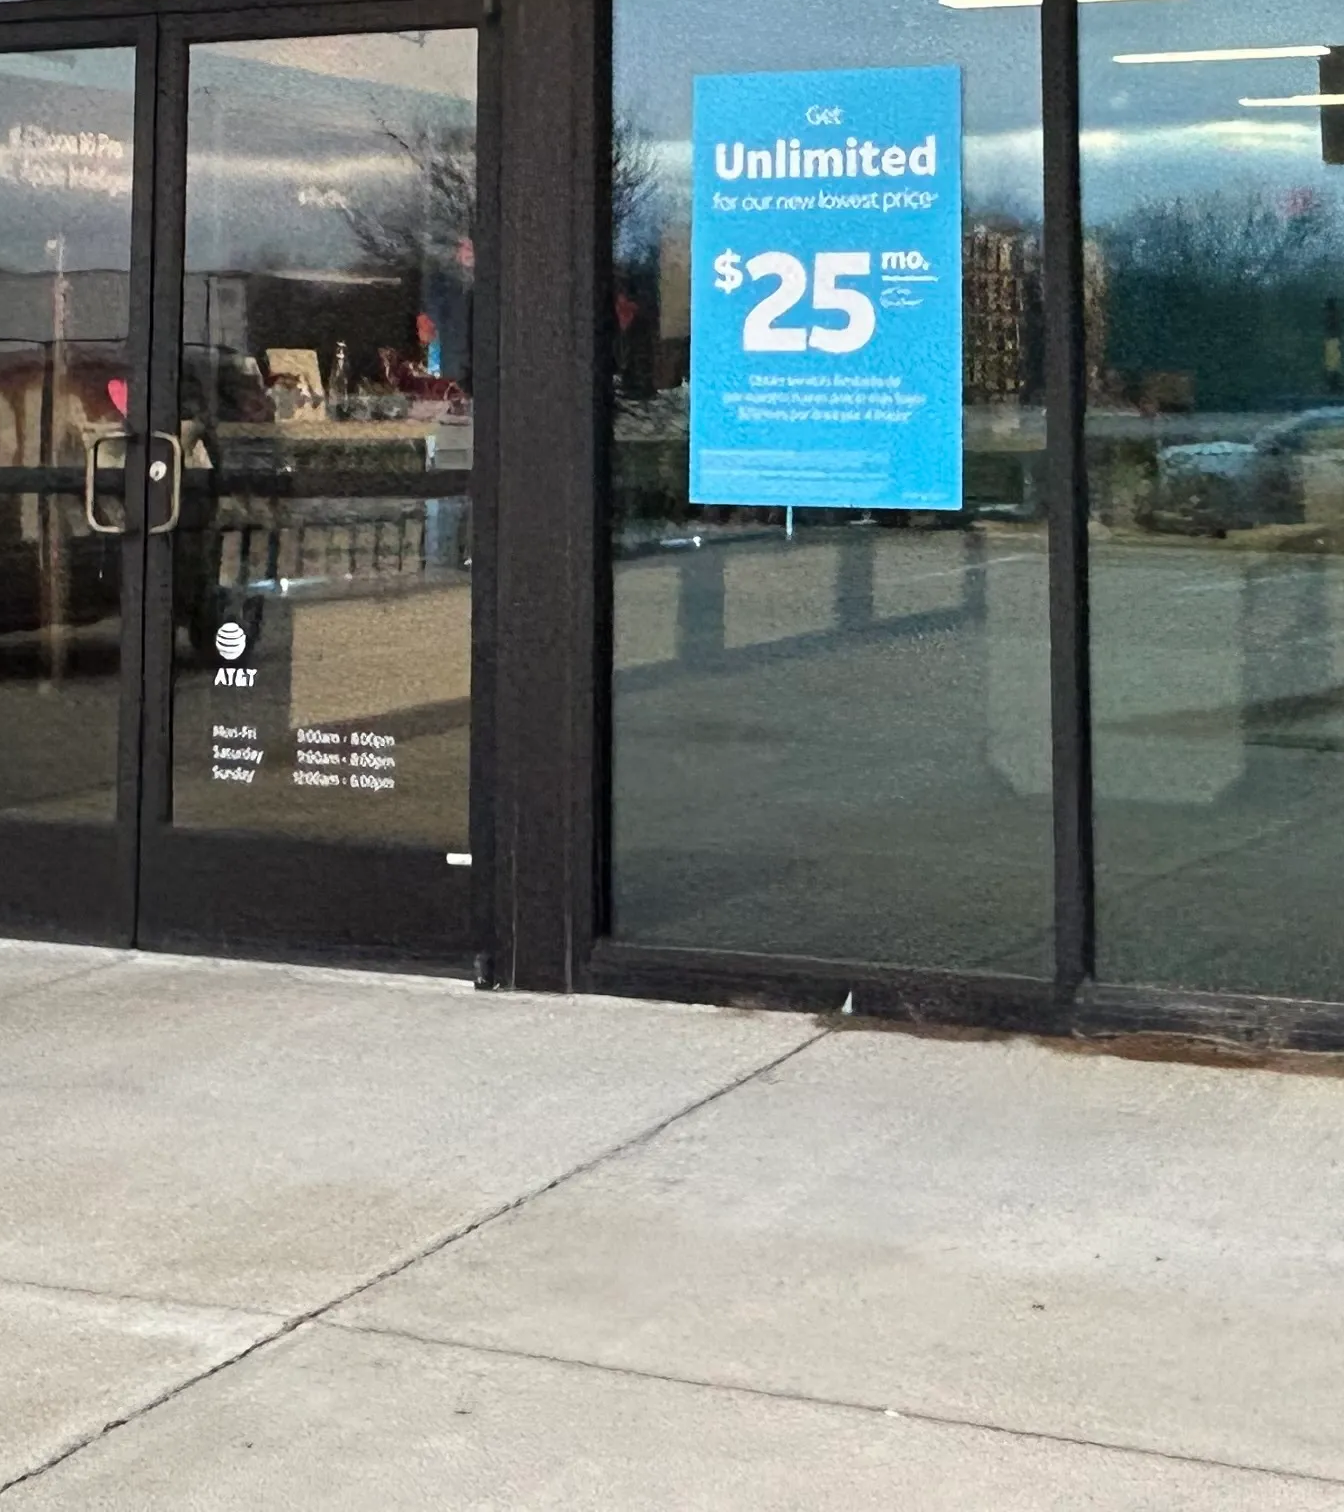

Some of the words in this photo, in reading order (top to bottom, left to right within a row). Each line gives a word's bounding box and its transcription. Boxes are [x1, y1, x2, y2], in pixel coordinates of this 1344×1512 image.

[806, 105, 844, 125] Get
[714, 134, 937, 180] Unlimited
[713, 192, 737, 210] for
[742, 196, 773, 211] our
[776, 196, 815, 210] new
[818, 190, 881, 210] lowest
[713, 248, 876, 354] $25
[881, 251, 930, 270] mo.
[214, 668, 257, 687] AT&T
[212, 744, 264, 764] Saturday
[211, 764, 256, 783] Sunday
